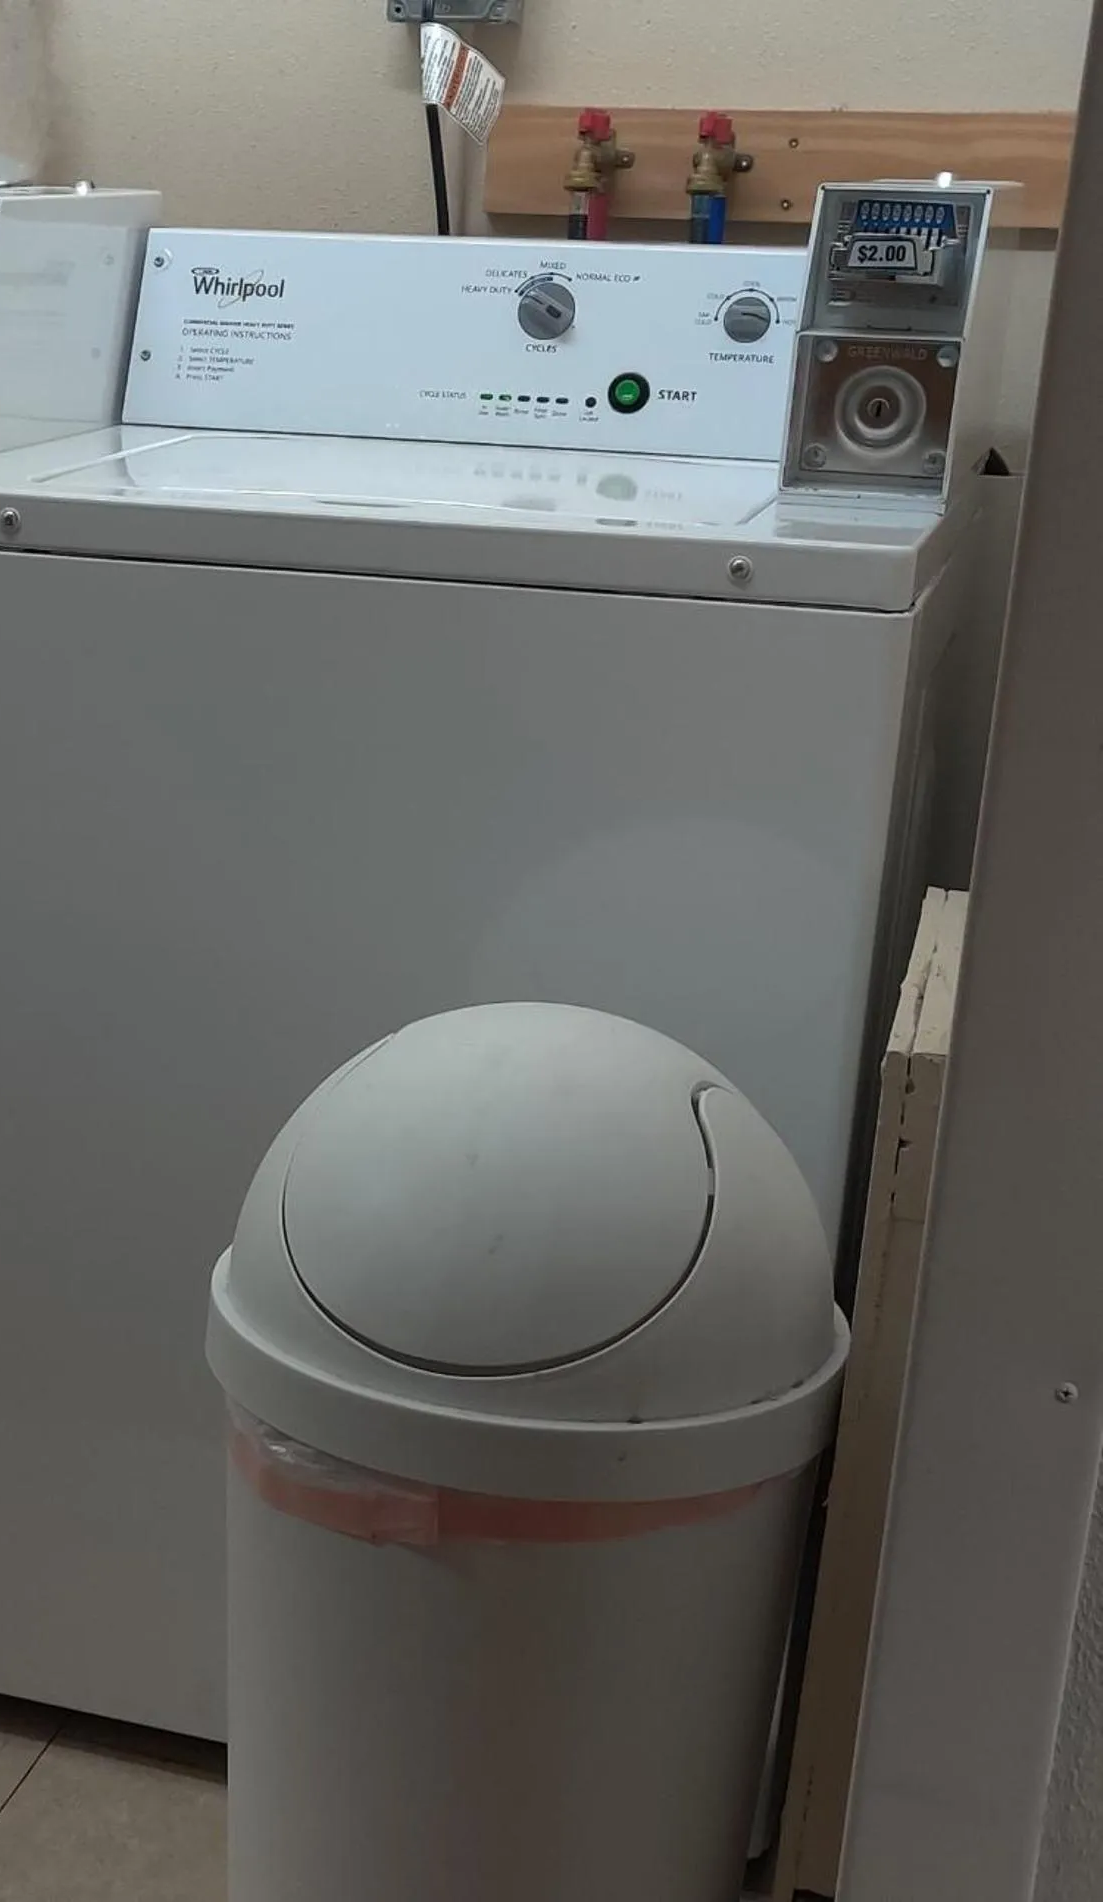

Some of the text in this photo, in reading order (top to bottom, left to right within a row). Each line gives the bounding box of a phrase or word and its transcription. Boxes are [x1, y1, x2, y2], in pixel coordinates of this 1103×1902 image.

[857, 245, 907, 264] $2.00
[540, 261, 566, 270] MIXED
[486, 269, 528, 278] DELICATES
[576, 272, 631, 282] NORMAL ECO
[193, 276, 285, 302] Whirlpool
[461, 285, 512, 295] HEAVY DUTY
[181, 327, 293, 341] OPERATING INSTRUCTIONS
[525, 344, 557, 353] CYCLES
[709, 352, 775, 364] TEMPERATURE
[657, 389, 698, 402] START
